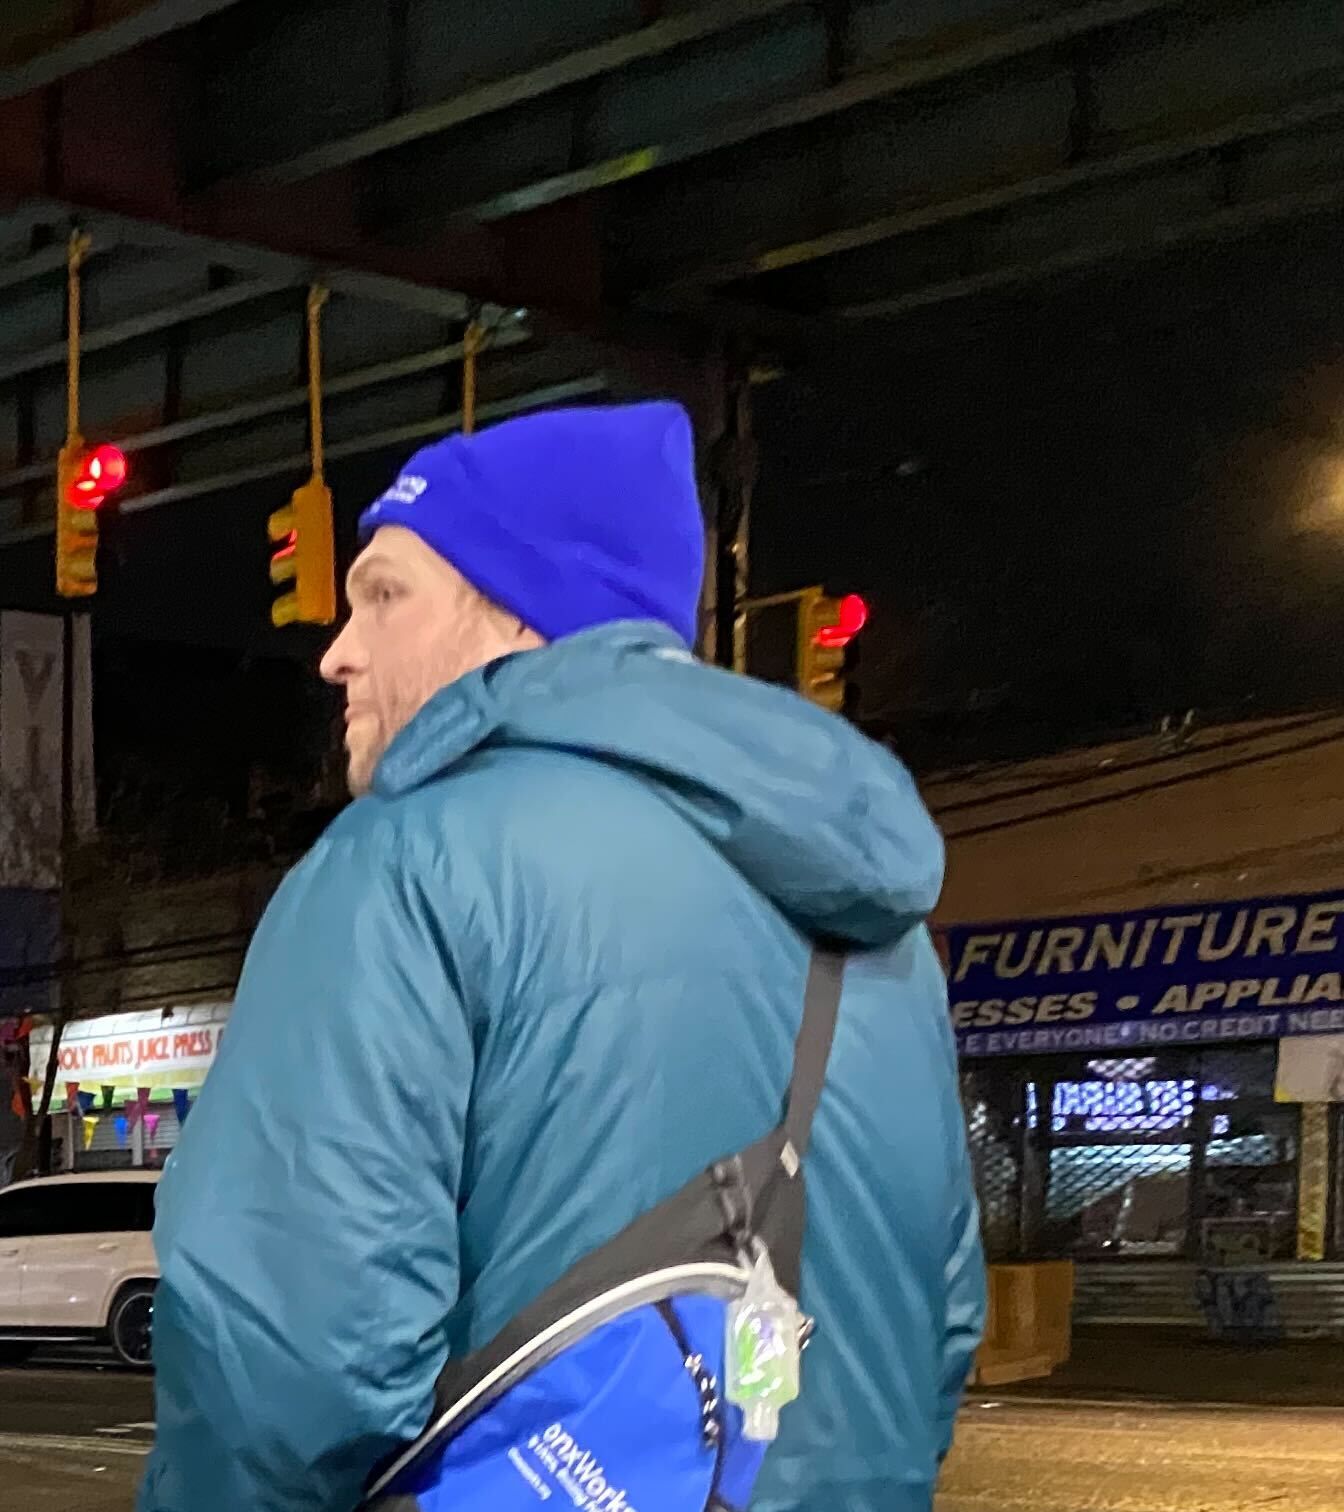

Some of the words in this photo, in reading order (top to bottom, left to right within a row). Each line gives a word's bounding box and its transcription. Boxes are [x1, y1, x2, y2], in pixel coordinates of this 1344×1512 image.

[953, 901, 1344, 983] FURNITURE
[92, 1040, 134, 1067] FRUITS
[135, 1034, 171, 1069] JUICE
[173, 1029, 213, 1058] PRESS
[986, 1025, 1120, 1052] EVERYONE
[1139, 1020, 1179, 1043] NO
[1181, 1013, 1280, 1040] CREDIT
